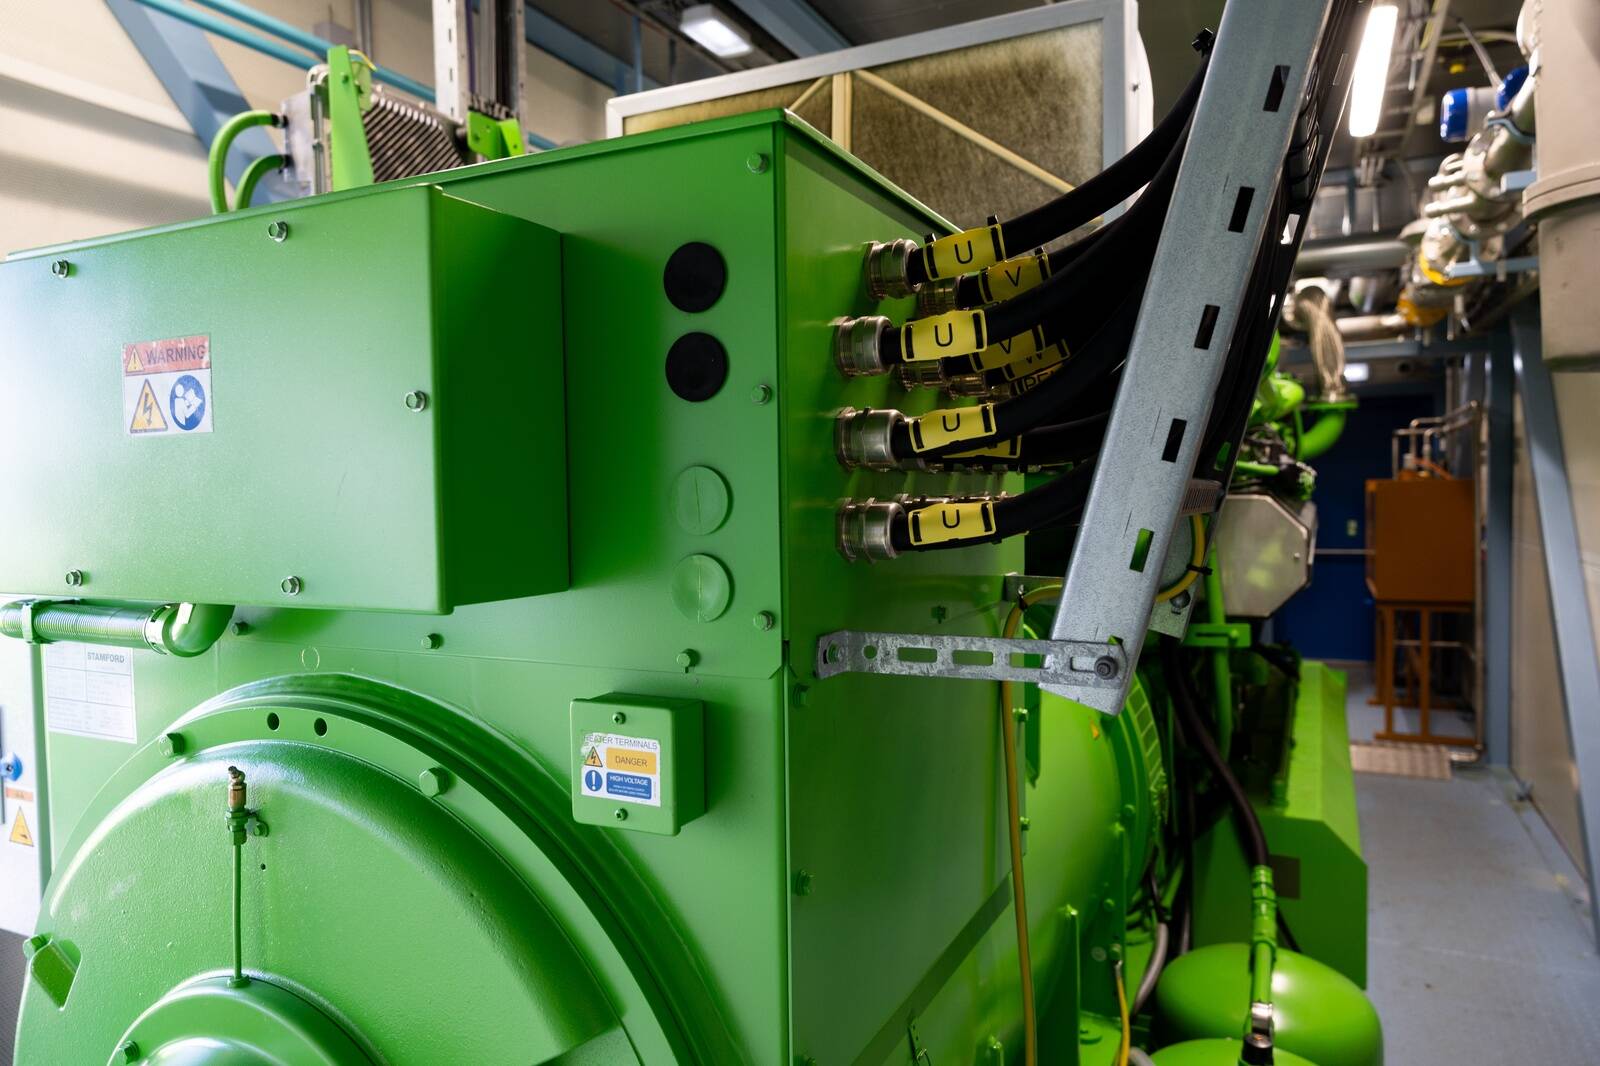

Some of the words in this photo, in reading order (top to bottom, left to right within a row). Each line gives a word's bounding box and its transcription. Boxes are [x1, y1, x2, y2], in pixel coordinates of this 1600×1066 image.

[954, 240, 974, 264] U
[1005, 266, 1021, 287] V
[934, 323, 953, 347] U
[146, 345, 206, 365] WARNING
[942, 413, 960, 432] U
[942, 509, 960, 529] U
[87, 652, 125, 663] STAMFORD
[615, 737, 658, 750] TERMINALS
[615, 755, 648, 768] DANGER
[624, 776, 649, 786] VOLTAGE
